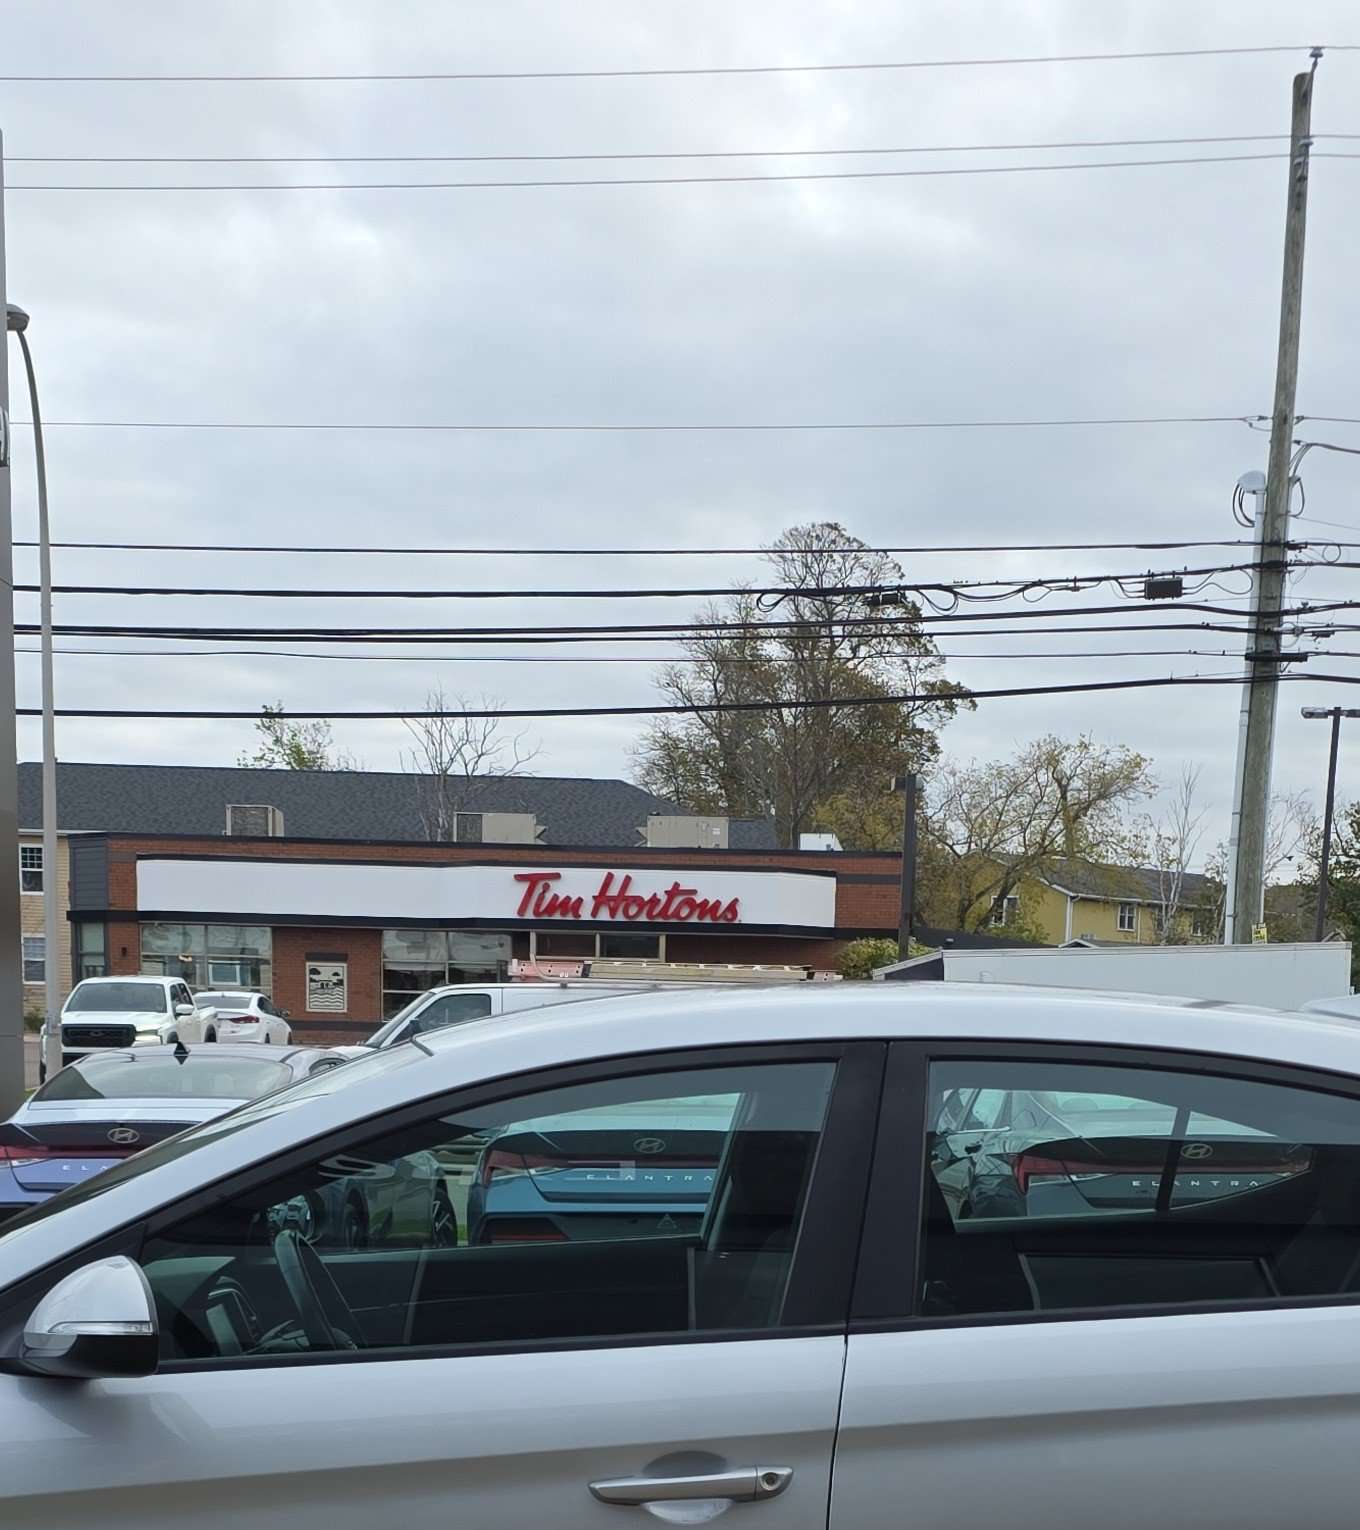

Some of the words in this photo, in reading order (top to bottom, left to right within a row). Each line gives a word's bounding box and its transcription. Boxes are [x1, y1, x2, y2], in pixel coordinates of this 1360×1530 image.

[513, 872, 584, 919] Tim
[590, 871, 740, 922] Hortons
[586, 1174, 713, 1182] ELANTRA
